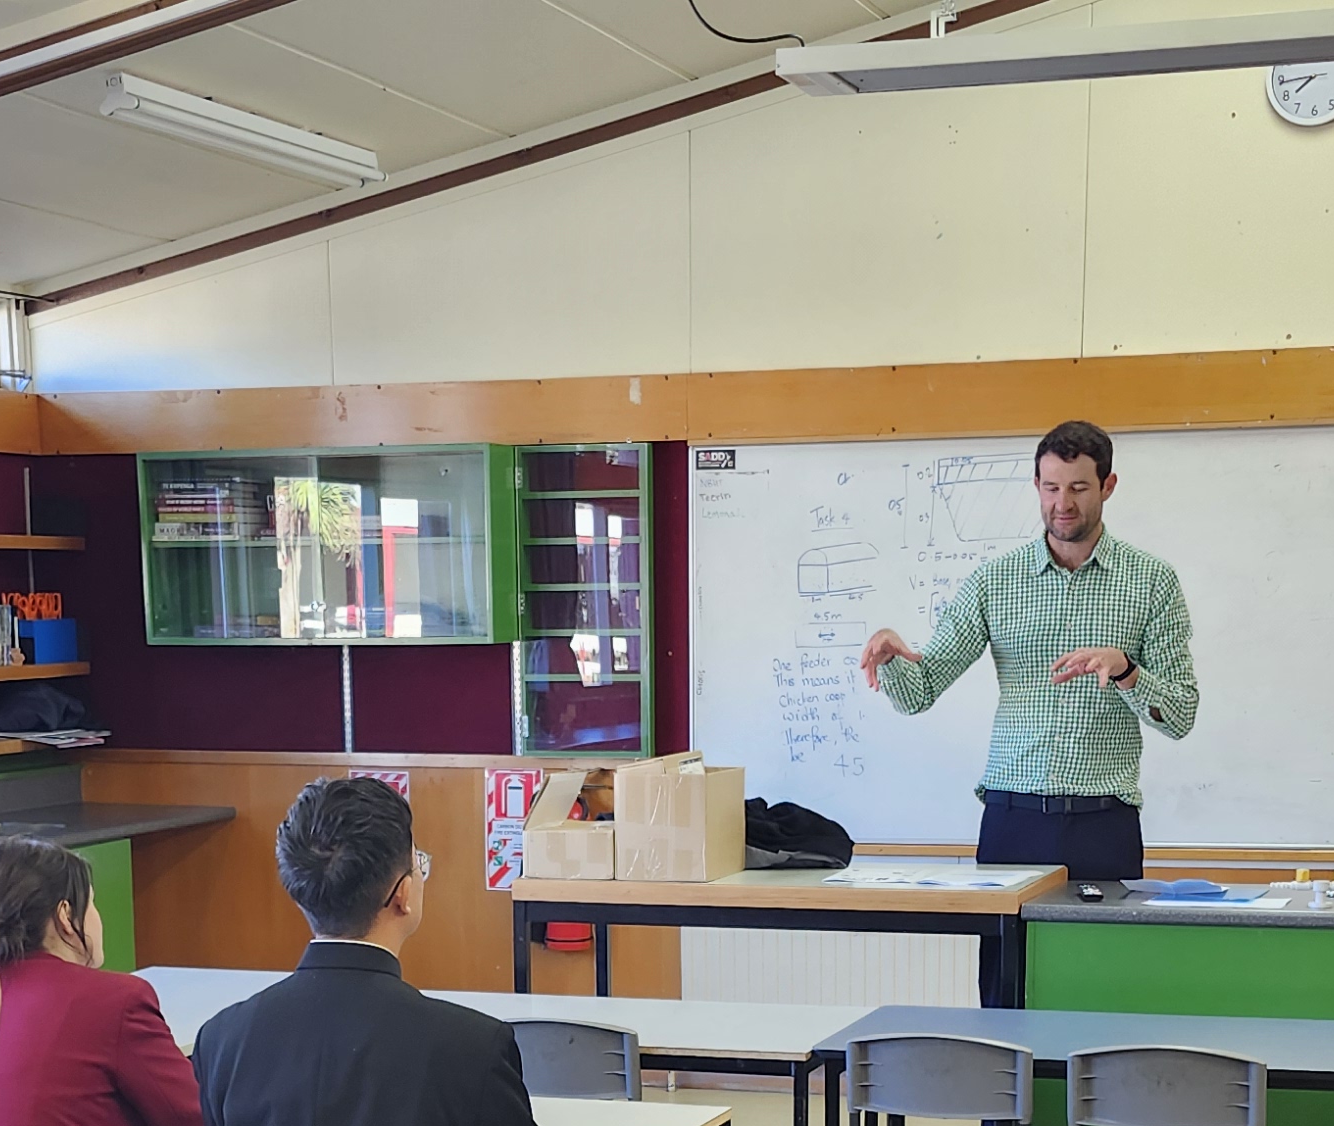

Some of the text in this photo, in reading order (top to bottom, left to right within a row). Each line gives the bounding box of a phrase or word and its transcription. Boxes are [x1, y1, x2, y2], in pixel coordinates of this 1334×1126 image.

[1283, 90, 1290, 101] 8
[1294, 103, 1301, 114] 7
[1328, 99, 1334, 110] 5
[1311, 105, 1318, 116] 6
[810, 505, 835, 528] Task
[772, 658, 792, 672] One
[773, 673, 795, 687] This
[802, 675, 840, 687] means
